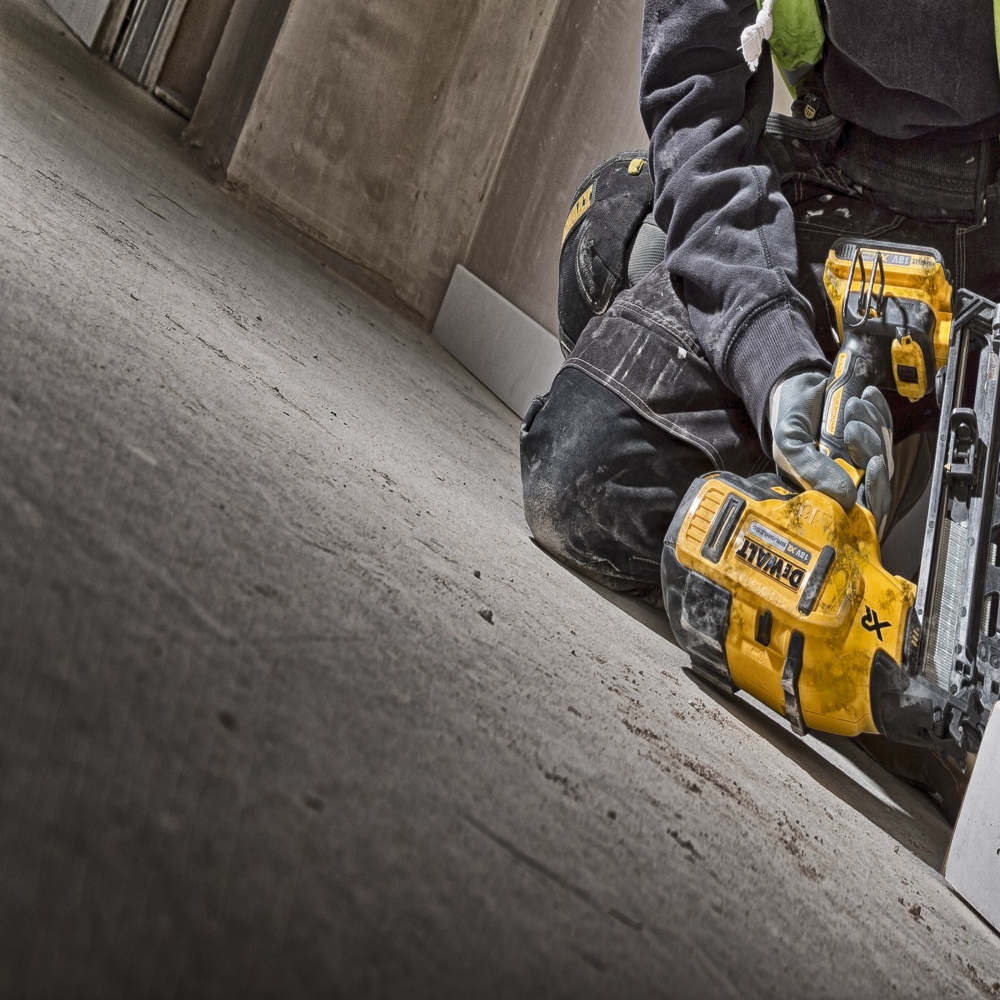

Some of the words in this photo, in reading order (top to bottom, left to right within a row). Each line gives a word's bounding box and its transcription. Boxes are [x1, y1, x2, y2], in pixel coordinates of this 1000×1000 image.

[892, 254, 910, 265] 18V
[751, 524, 787, 548] BRUSHLESS
[736, 539, 806, 589] DEWALT
[796, 549, 810, 562] 18V
[860, 605, 892, 642] XR
